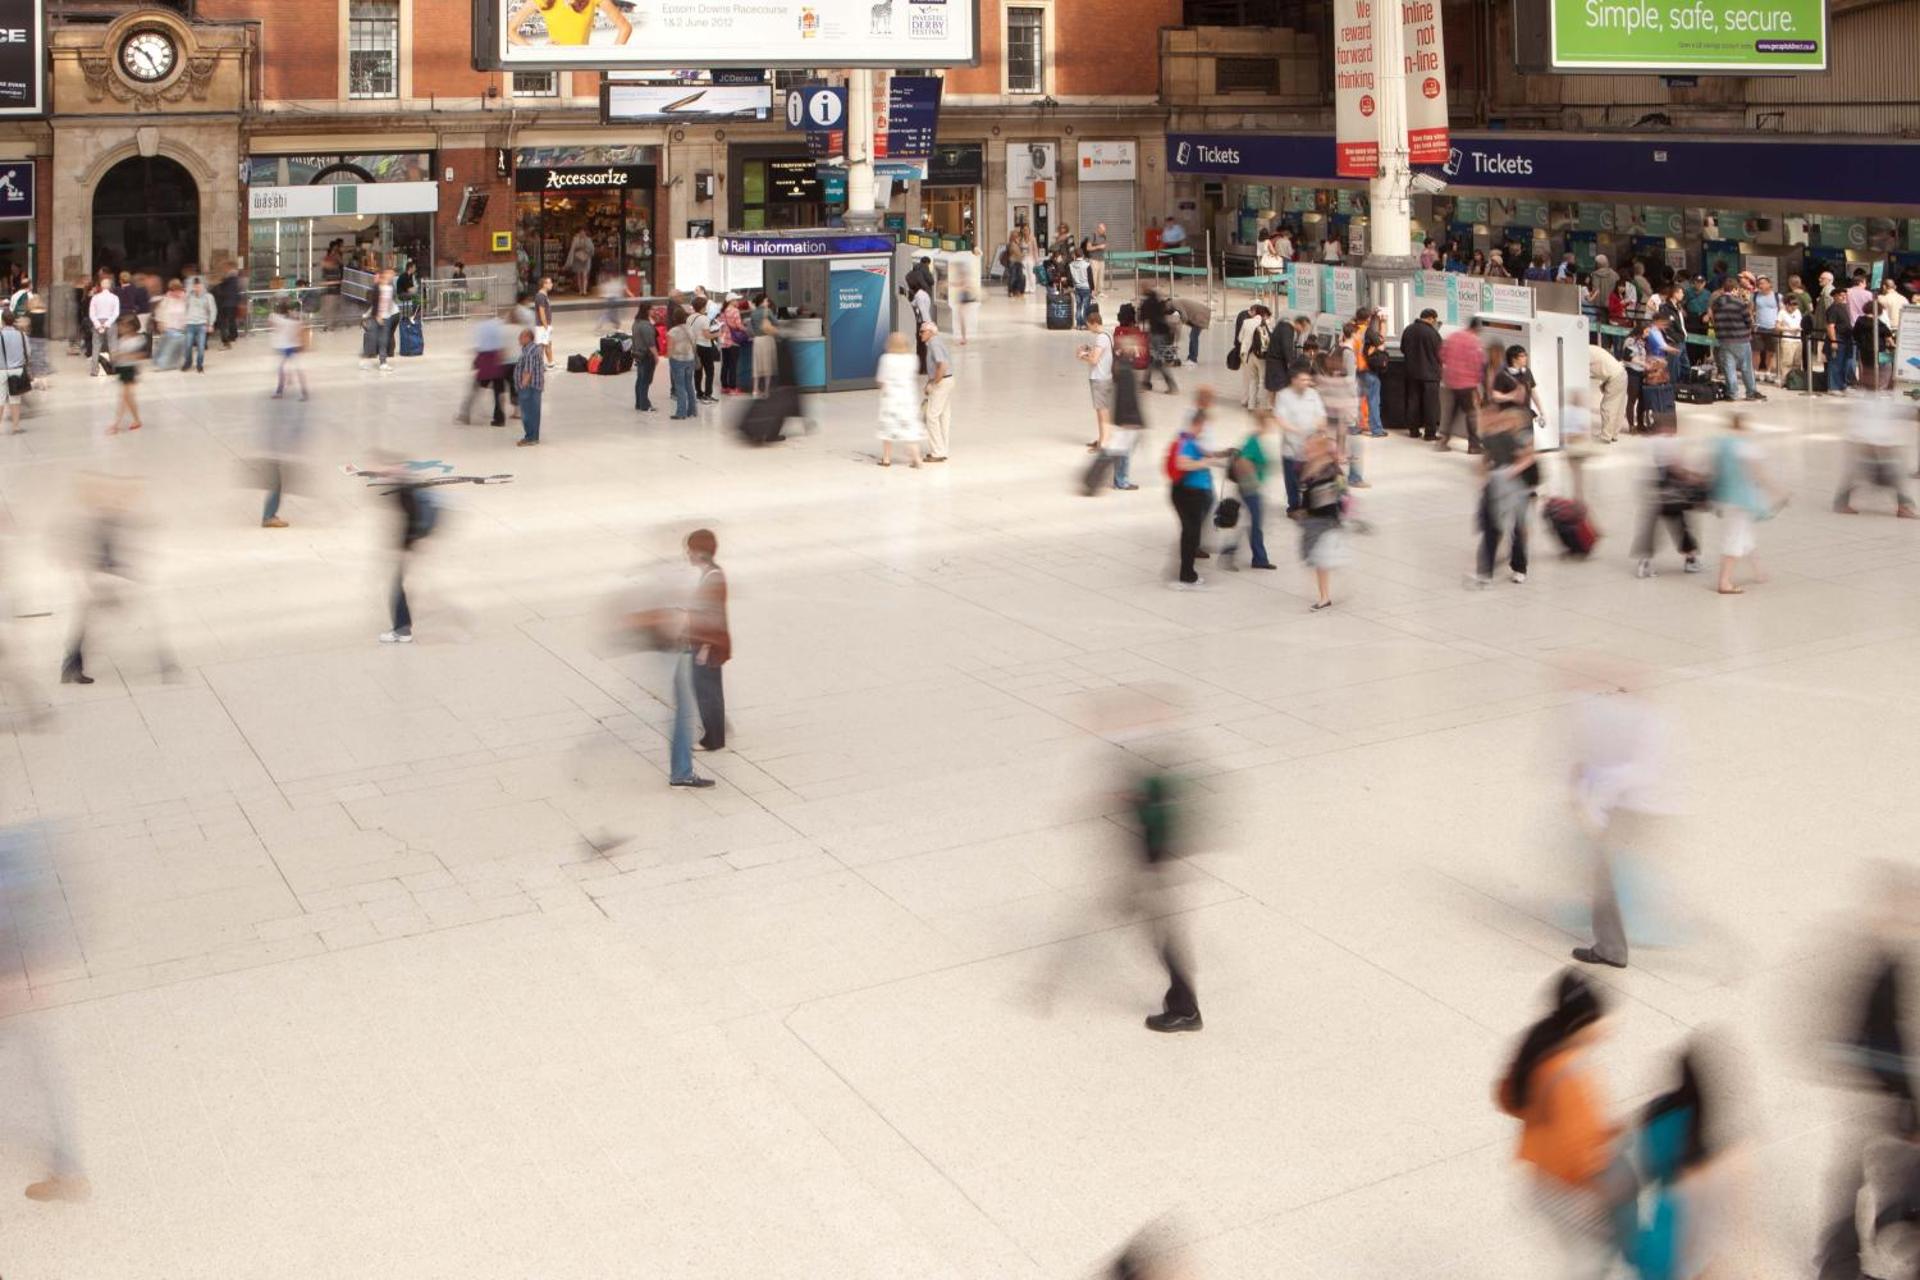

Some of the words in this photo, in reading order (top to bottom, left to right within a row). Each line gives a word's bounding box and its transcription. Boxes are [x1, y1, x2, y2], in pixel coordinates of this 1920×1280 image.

[662, 3, 696, 15] Epsom
[698, 3, 731, 14] Downs
[733, 3, 789, 14] Racecourse
[1356, 2, 1370, 19] We
[1585, 0, 1663, 35] Simple,
[1669, 0, 1719, 34] safe,
[1724, 10, 1797, 32] secure.
[685, 18, 709, 28] June
[711, 18, 734, 28] 2012
[911, 21, 945, 29] DERBY
[1341, 21, 1372, 42] reward
[1416, 24, 1435, 47] not
[1337, 44, 1373, 65] forward
[1404, 50, 1438, 75] n-line
[1337, 70, 1374, 91] thinking
[1196, 145, 1240, 164] Tickets
[1471, 152, 1534, 175] Tickets
[545, 168, 628, 189] Accessorize
[254, 194, 288, 209] wasabi
[731, 240, 751, 253] Rail
[753, 239, 827, 254] information
